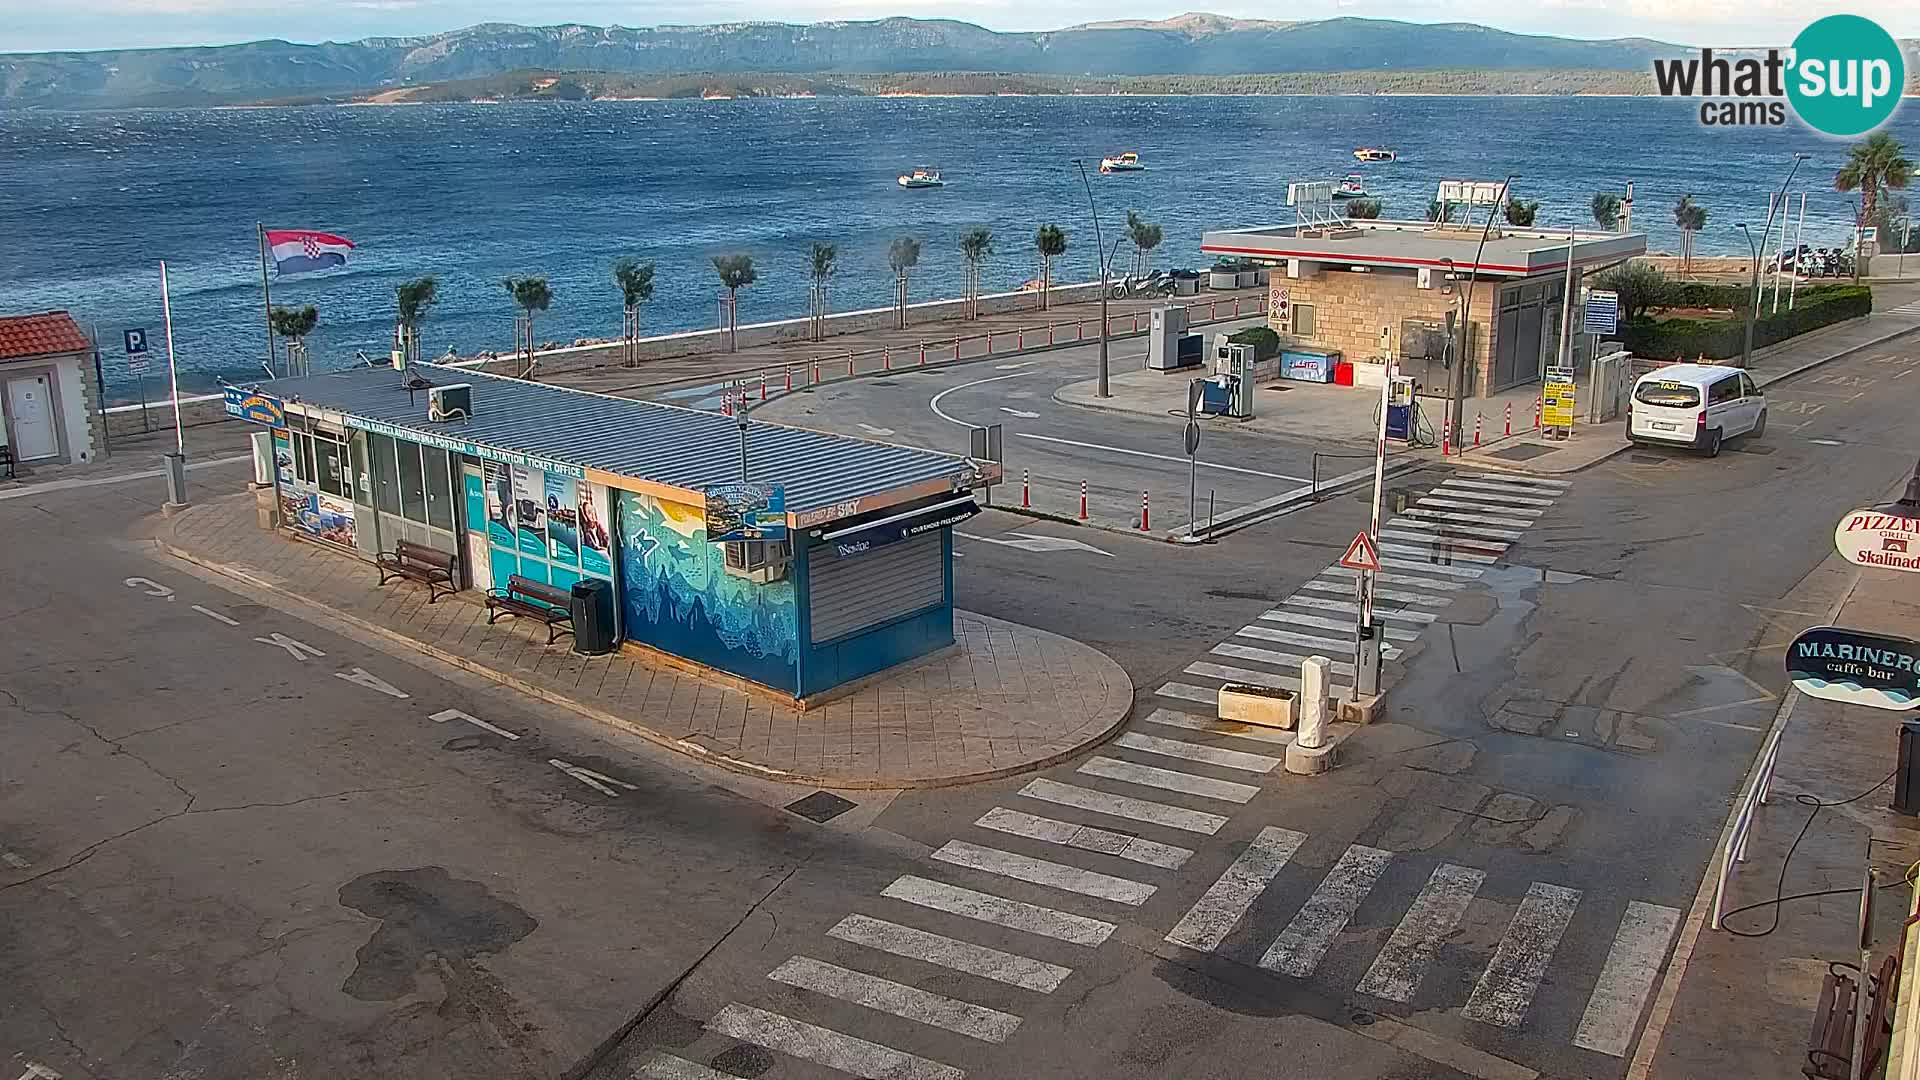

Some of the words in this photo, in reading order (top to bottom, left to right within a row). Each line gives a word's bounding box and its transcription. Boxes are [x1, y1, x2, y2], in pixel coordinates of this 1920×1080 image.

[129, 331, 141, 350] P
[1660, 382, 1679, 391] TAXI
[345, 417, 371, 431] PRODAJA
[394, 428, 434, 445] AUTOBUSNA
[434, 437, 467, 452] POSTAJA
[477, 446, 493, 459] BUS
[493, 450, 525, 465] STATION
[527, 458, 553, 473] TICKET
[554, 464, 581, 478] OFFICE
[1879, 530, 1914, 541] GRILL
[1826, 662, 1864, 675] caffe
[1868, 665, 1895, 681] bar
